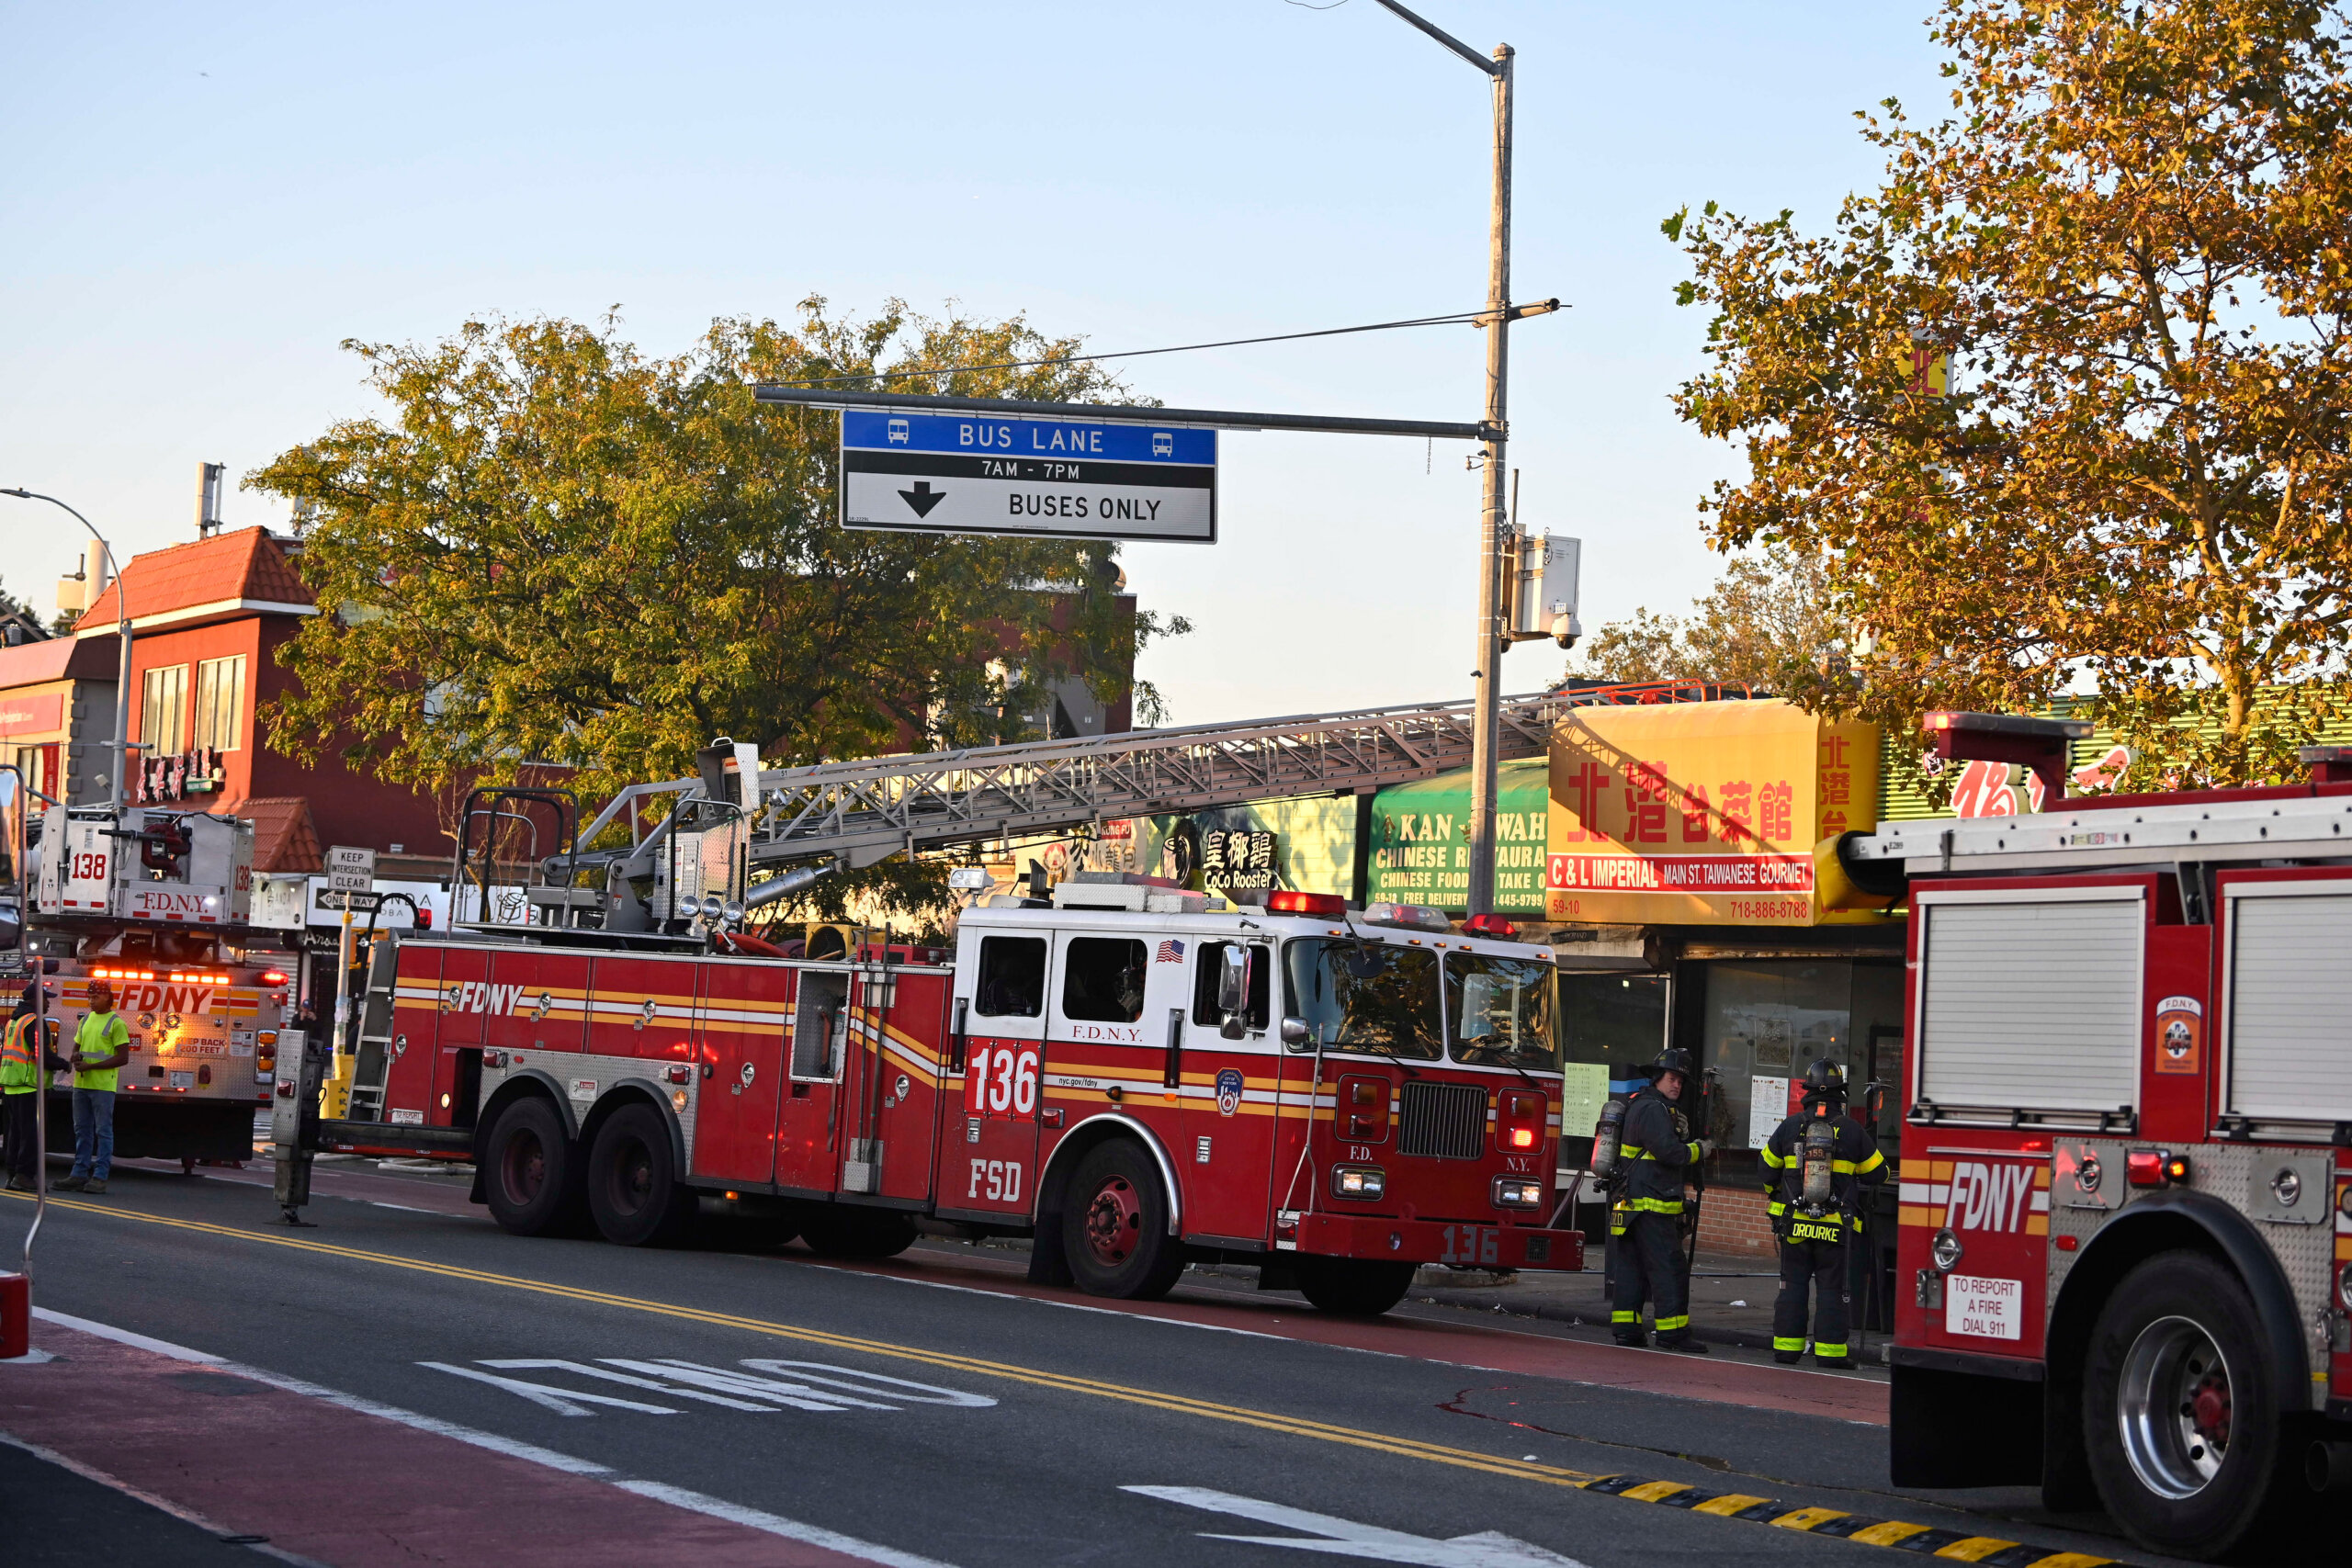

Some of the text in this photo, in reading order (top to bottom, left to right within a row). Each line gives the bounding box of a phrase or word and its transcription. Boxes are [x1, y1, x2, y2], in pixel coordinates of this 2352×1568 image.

[959, 423, 1102, 453] BUS LANE
[981, 460, 1018, 477] 7AM
[1043, 463, 1080, 479] 7PM
[1009, 493, 1161, 521] BUSES ONLY
[1566, 760, 1792, 843] 北港台菜館
[1121, 823, 1131, 835] FU
[1399, 812, 1547, 841] KAN WAH
[72, 852, 107, 880] 138
[341, 852, 364, 863] KEEP
[1375, 846, 1447, 869] CHINESE
[234, 864, 250, 891] 138
[331, 865, 371, 876] INTERSECTION
[1204, 869, 1272, 889] CoCo Rooster
[1380, 872, 1431, 888] CHINESE
[1437, 872, 1469, 888] FOOD
[1498, 873, 1531, 888] TAKE
[1552, 857, 1807, 888] C & L IMPERIAL MAIN ST. TAIWANESE GOURMET
[335, 876, 365, 889] CLEAR
[142, 891, 209, 914] F.D.N.Y.
[325, 895, 375, 908] ONE WAY
[1403, 892, 1424, 905] FREE
[1428, 892, 1469, 906] DELIVERY
[1552, 899, 1808, 919] 59-10 718-886-8788
[119, 984, 211, 1014] FDNY
[458, 981, 525, 1016] FDNY
[1072, 1025, 1143, 1043] F.D.N.Y.
[971, 1048, 1038, 1113] 136
[1058, 1077, 1098, 1089] nyc.gov/fdny
[1350, 1145, 1374, 1161] F.D.
[1506, 1157, 1530, 1172] N.Y.
[968, 1158, 1022, 1202] FSD
[1945, 1161, 2034, 1233] FDNY
[1792, 1223, 1840, 1243] OROURKE
[1441, 1225, 1500, 1264] 136
[1954, 1278, 2015, 1297] TO REPORT
[1967, 1299, 2003, 1315] A FIRE
[1962, 1318, 2007, 1336] DIAL 911
